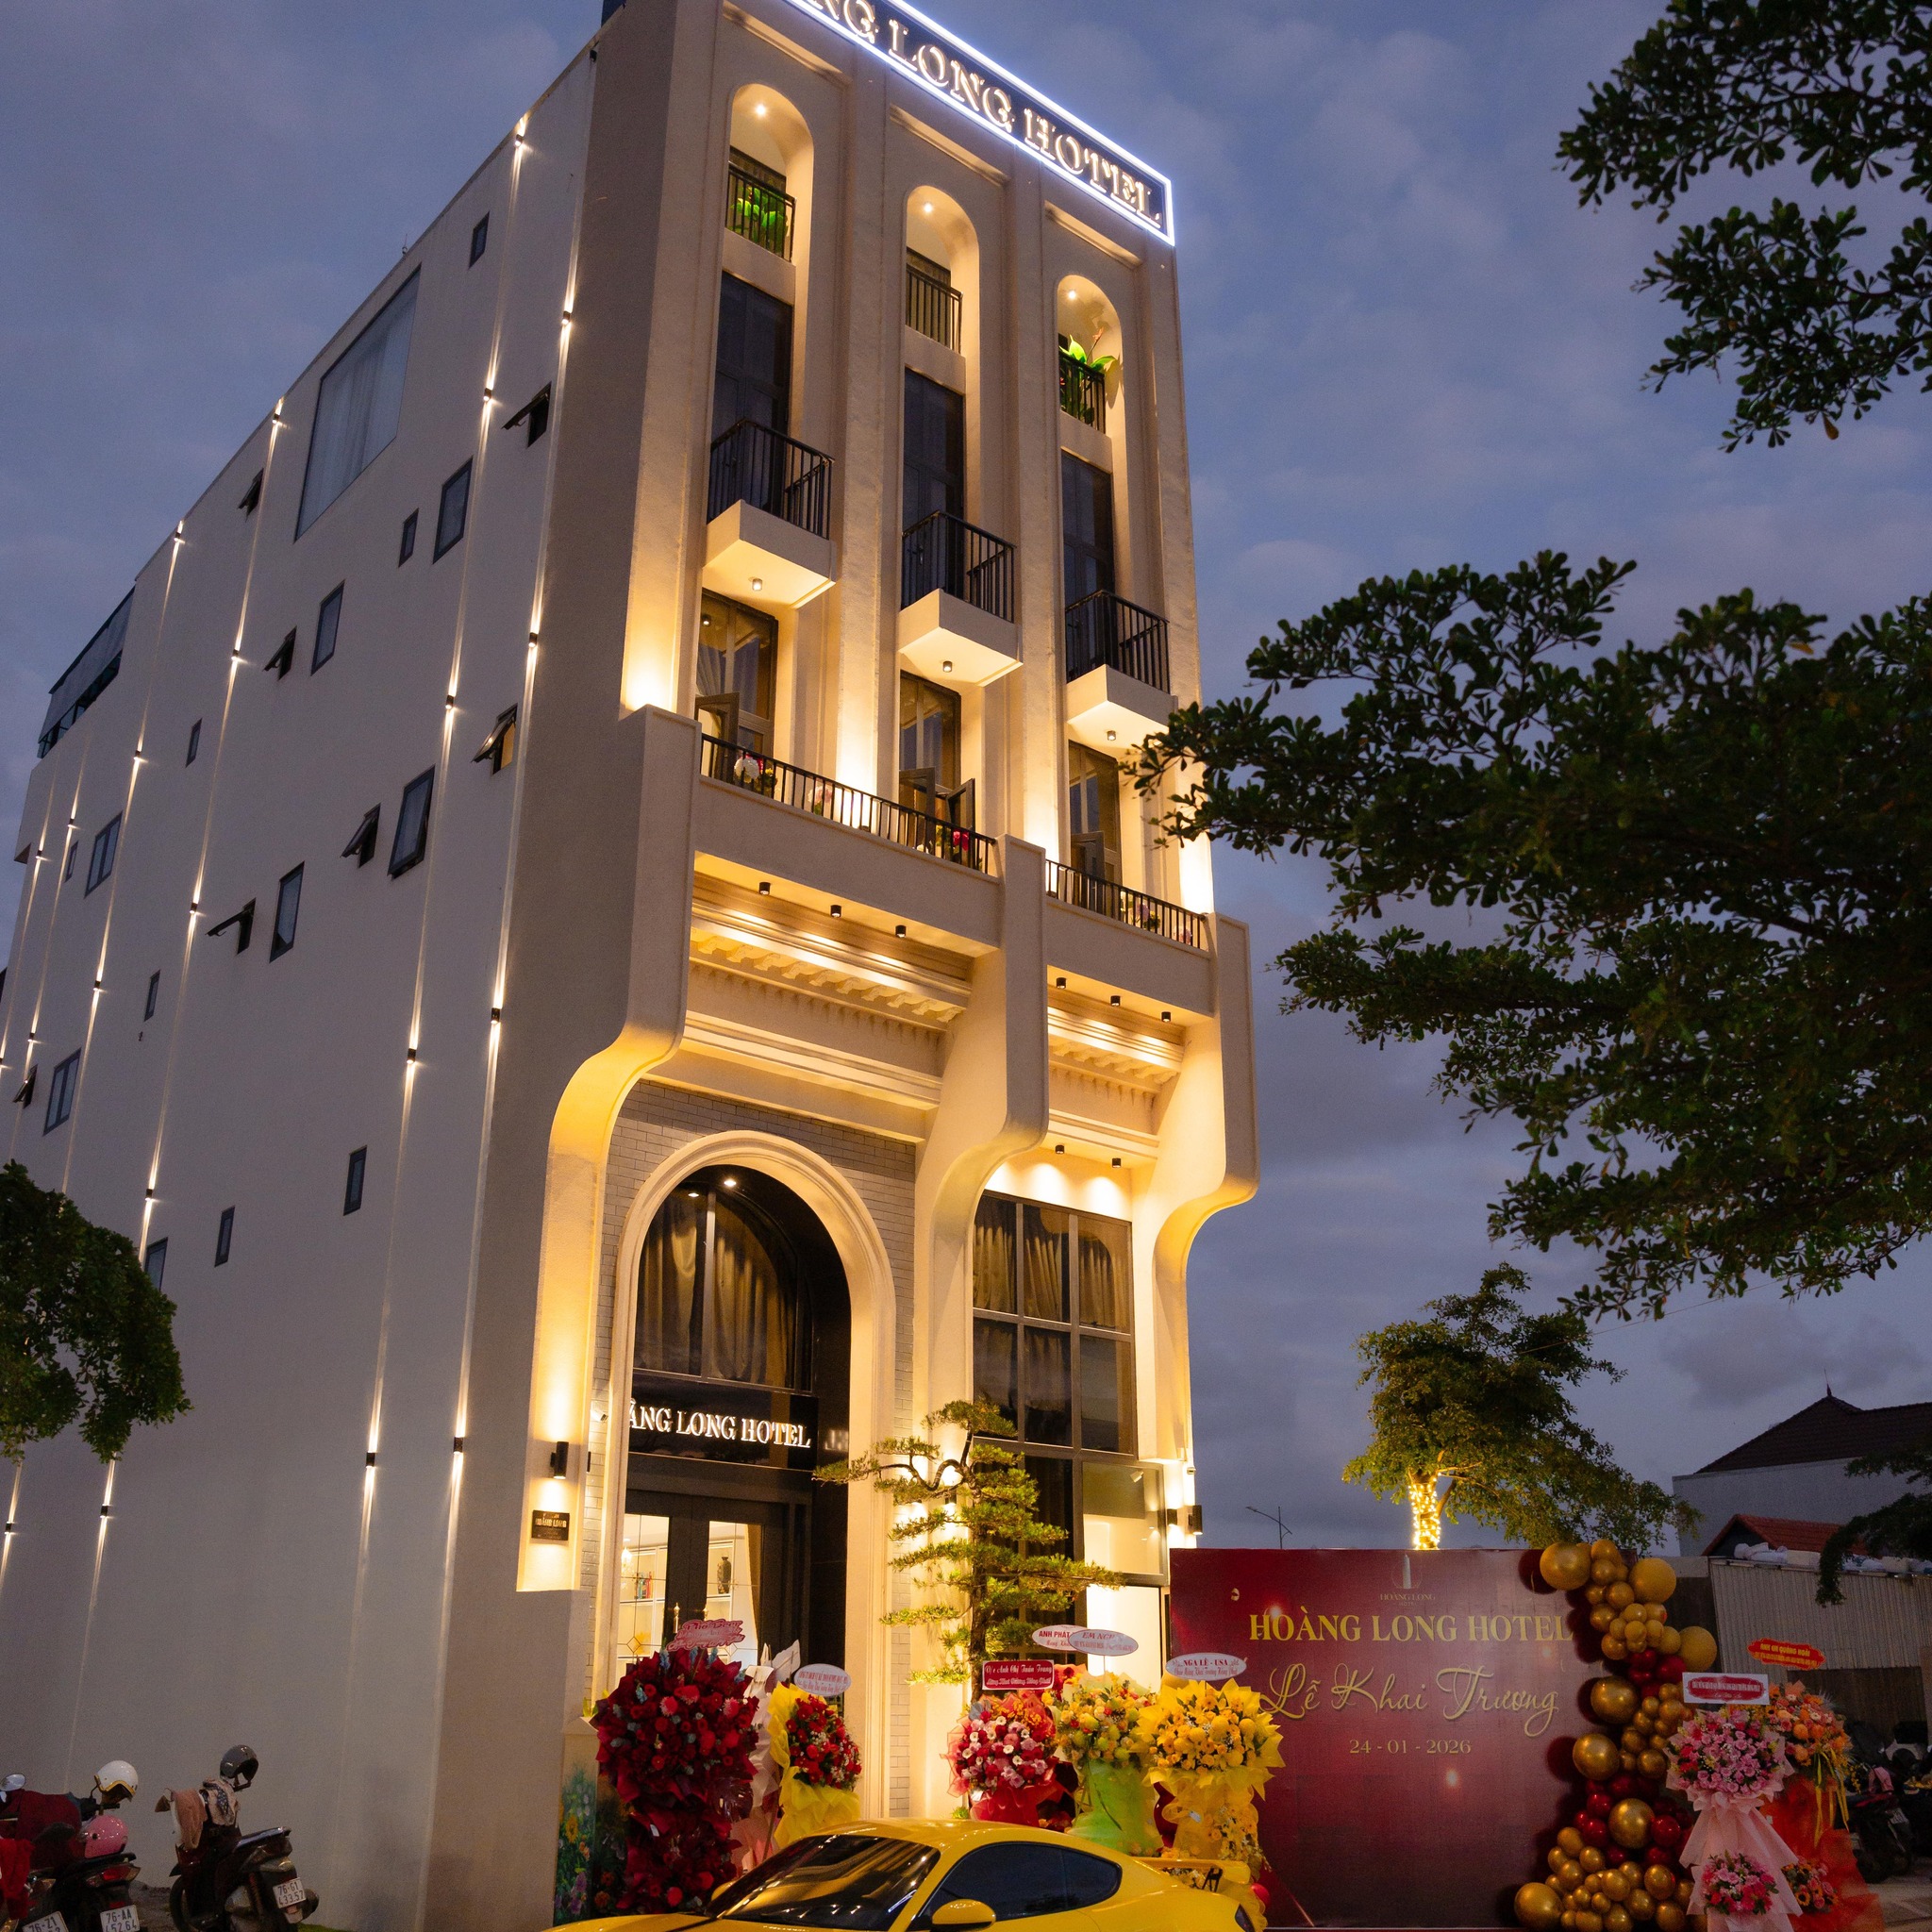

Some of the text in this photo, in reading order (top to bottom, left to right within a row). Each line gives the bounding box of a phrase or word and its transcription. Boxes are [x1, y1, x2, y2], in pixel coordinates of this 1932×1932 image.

[889, 19, 1016, 133] LONG
[1024, 108, 1161, 228] HOTEL
[675, 1410, 736, 1440] LONG
[741, 1418, 811, 1448] HOTEL
[1249, 1606, 1574, 1641] HOÀNG LONG HOTEL
[1258, 1663, 1321, 1719] Lễ
[1331, 1663, 1428, 1713] Khai
[1349, 1739, 1372, 1754] 24
[1387, 1739, 1407, 1754] 01
[1426, 1739, 1472, 1754] 2026
[106, 1908, 132, 1924] 76-AA
